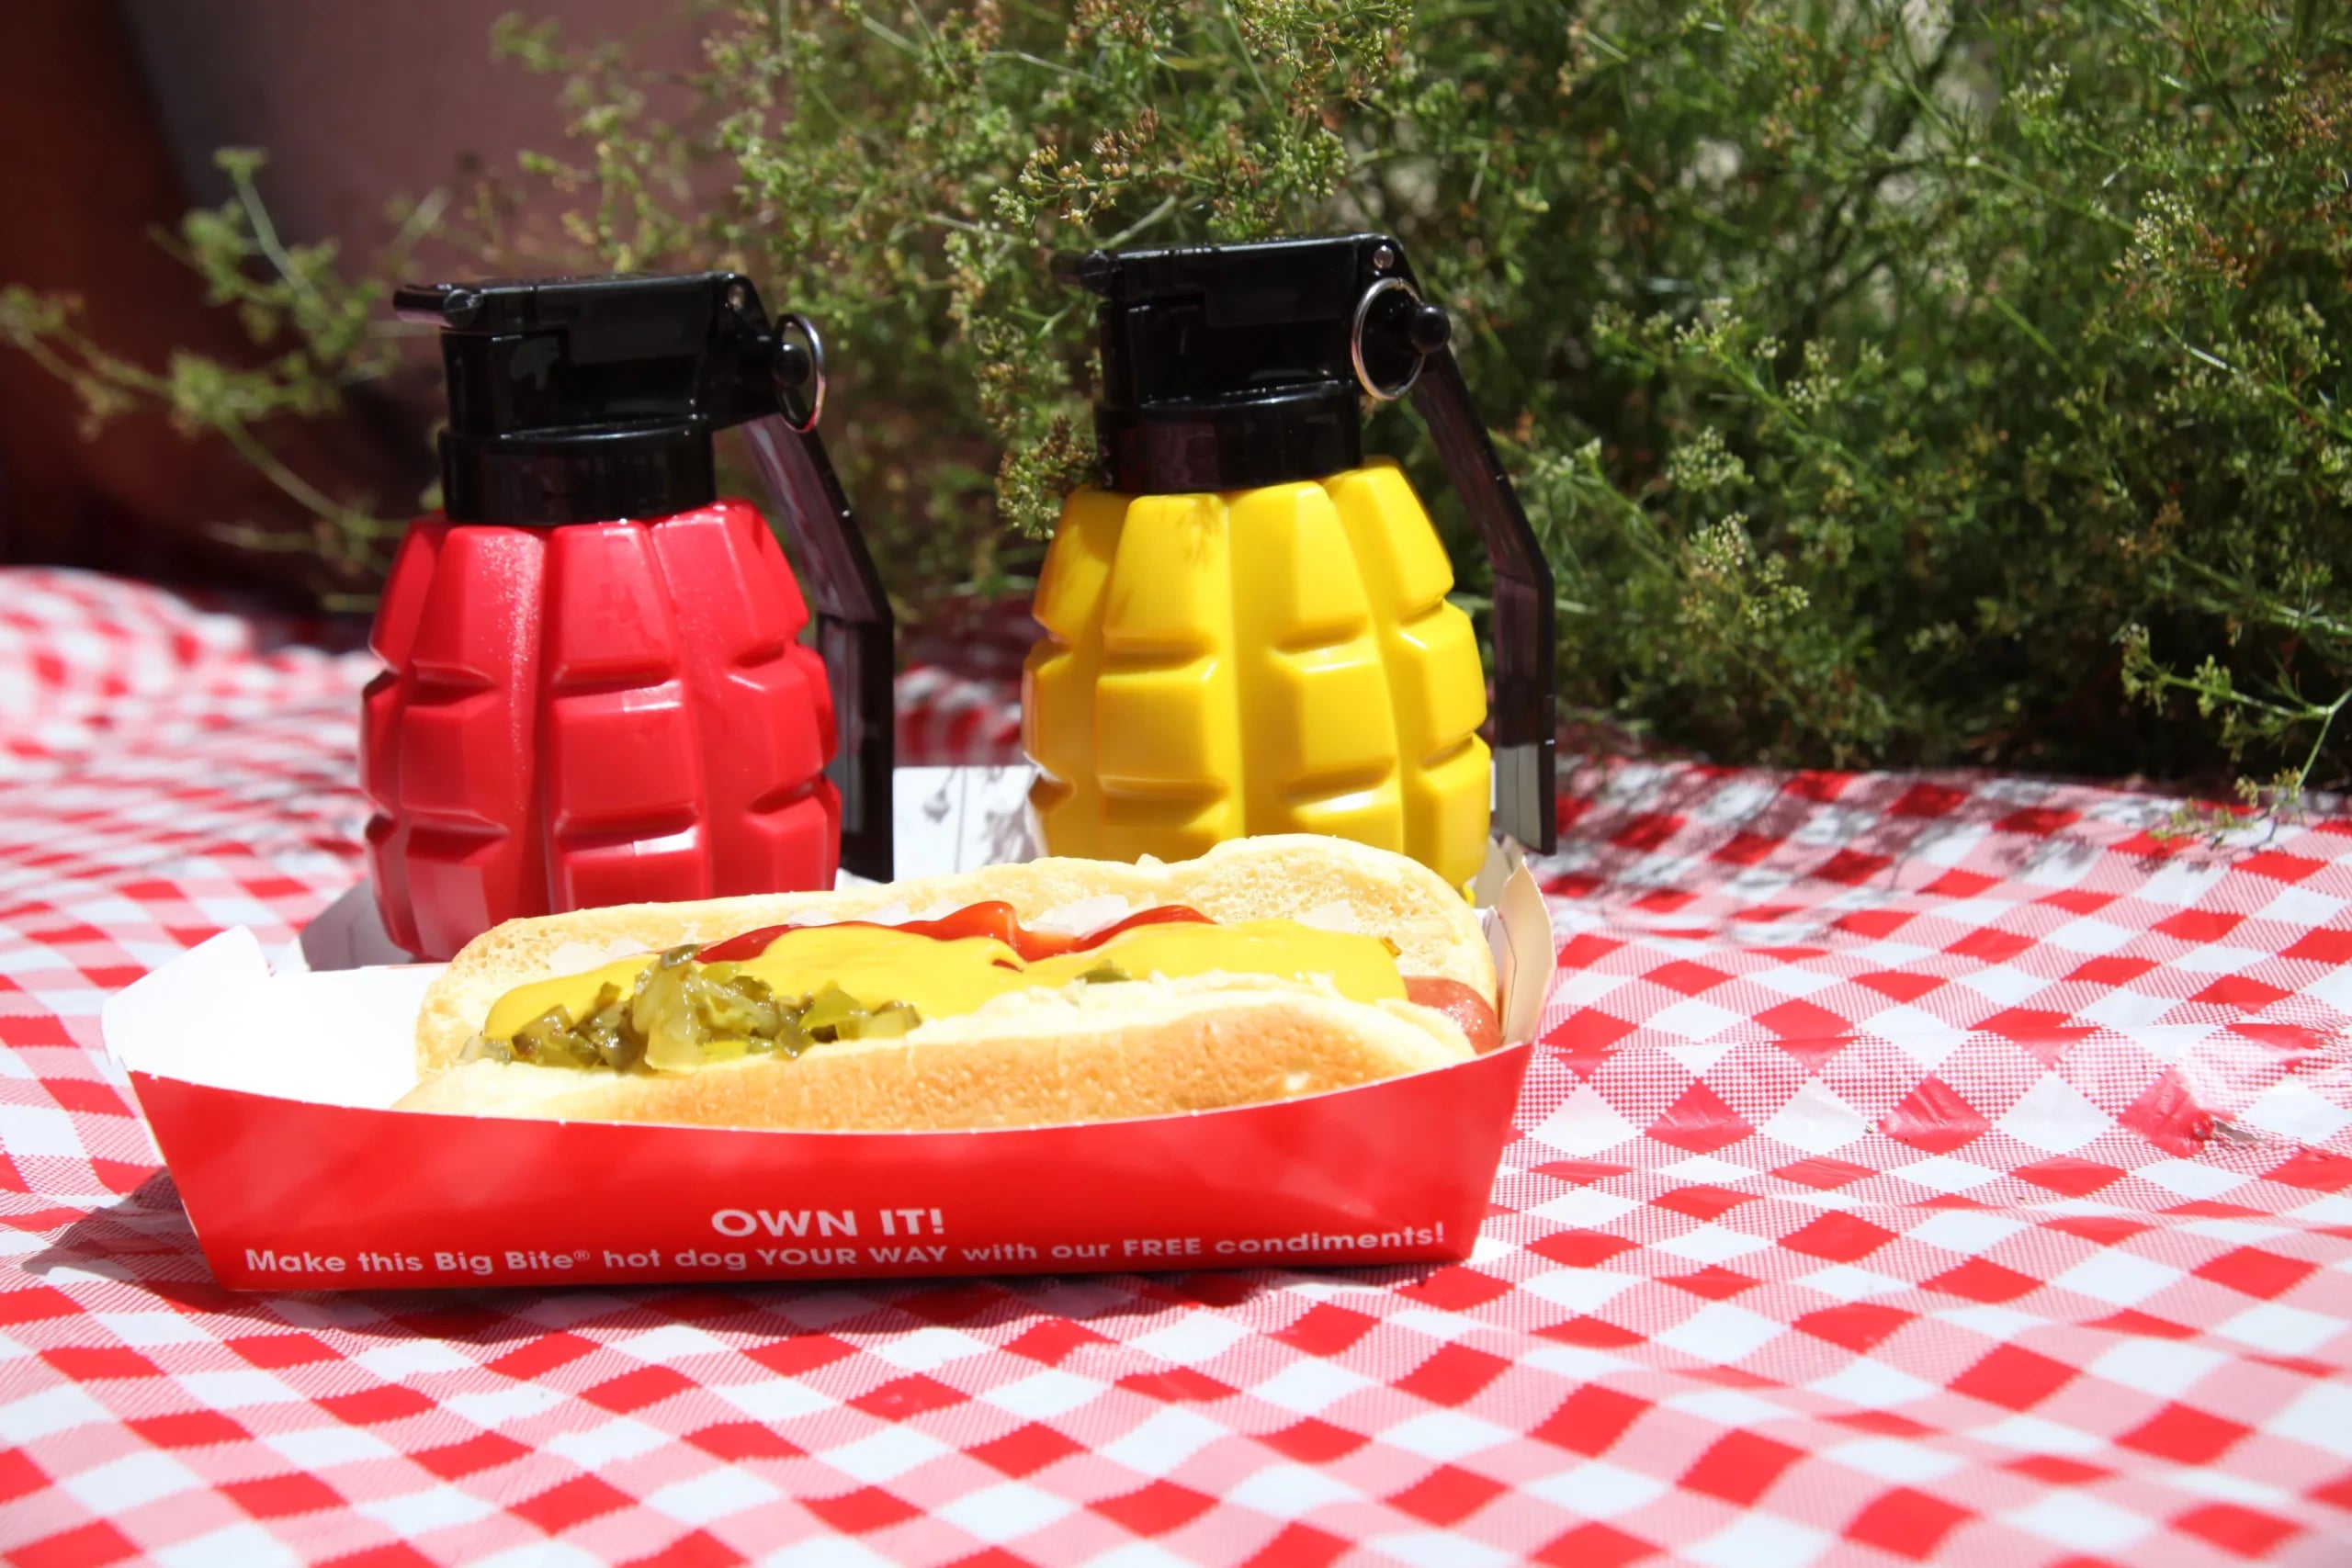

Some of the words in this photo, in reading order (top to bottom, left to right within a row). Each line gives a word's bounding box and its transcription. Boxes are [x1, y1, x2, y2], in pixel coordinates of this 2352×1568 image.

[710, 1209, 858, 1237] OWN
[879, 1208, 944, 1235] IT!
[245, 1248, 346, 1273] Make
[357, 1251, 424, 1272] this
[434, 1251, 494, 1275] Big
[603, 1249, 662, 1269] hot
[673, 1247, 747, 1271] dog
[756, 1247, 858, 1267] YOUR
[868, 1246, 949, 1265] WAY
[961, 1241, 1038, 1262] with
[1050, 1243, 1111, 1259] our
[1123, 1237, 1202, 1257] FREE
[1214, 1222, 1445, 1256] condiments!
